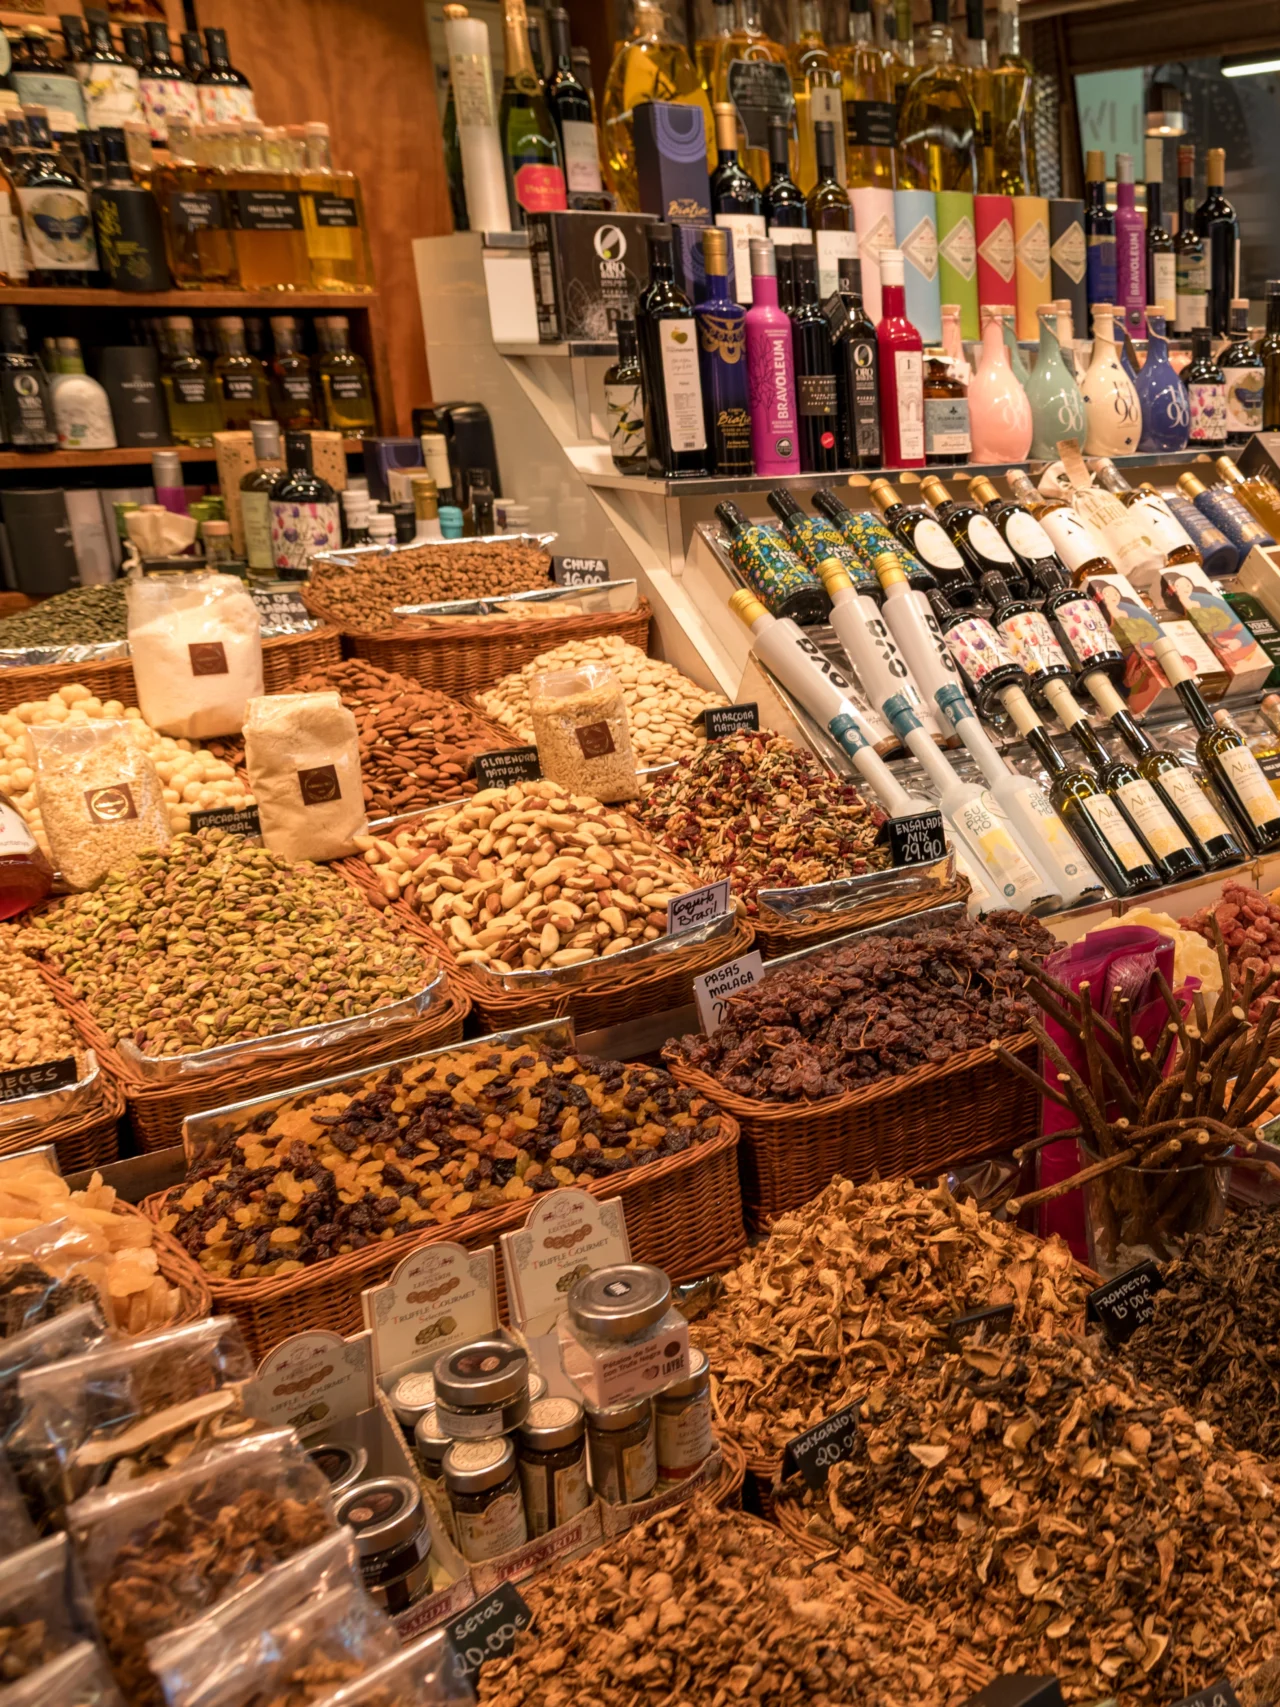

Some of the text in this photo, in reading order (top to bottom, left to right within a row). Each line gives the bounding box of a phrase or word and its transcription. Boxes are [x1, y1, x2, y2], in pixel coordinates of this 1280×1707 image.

[1129, 232, 1140, 296] BRAVOLEUM
[773, 340, 789, 419] BRAVOLEUM
[562, 558, 606, 572] CHUFA
[712, 710, 755, 723] MARCONA
[485, 766, 528, 779] NATURAL
[963, 805, 981, 818] SU
[965, 811, 990, 830] PRE
[895, 816, 942, 836] ENSALADA
[973, 821, 992, 836] MO
[907, 830, 930, 844] MIX
[704, 963, 741, 987] PASAS
[708, 972, 755, 999] MALAGA
[0, 1067, 58, 1089] ECES
[531, 1237, 609, 1270] TRUFFLE GOURMET
[556, 1255, 588, 1270] Selection
[391, 1289, 476, 1324] TRUFFLE GOURMET
[418, 1308, 452, 1323] Selection
[502, 1529, 579, 1579] LEONARDI
[400, 1600, 449, 1635] NARDI
